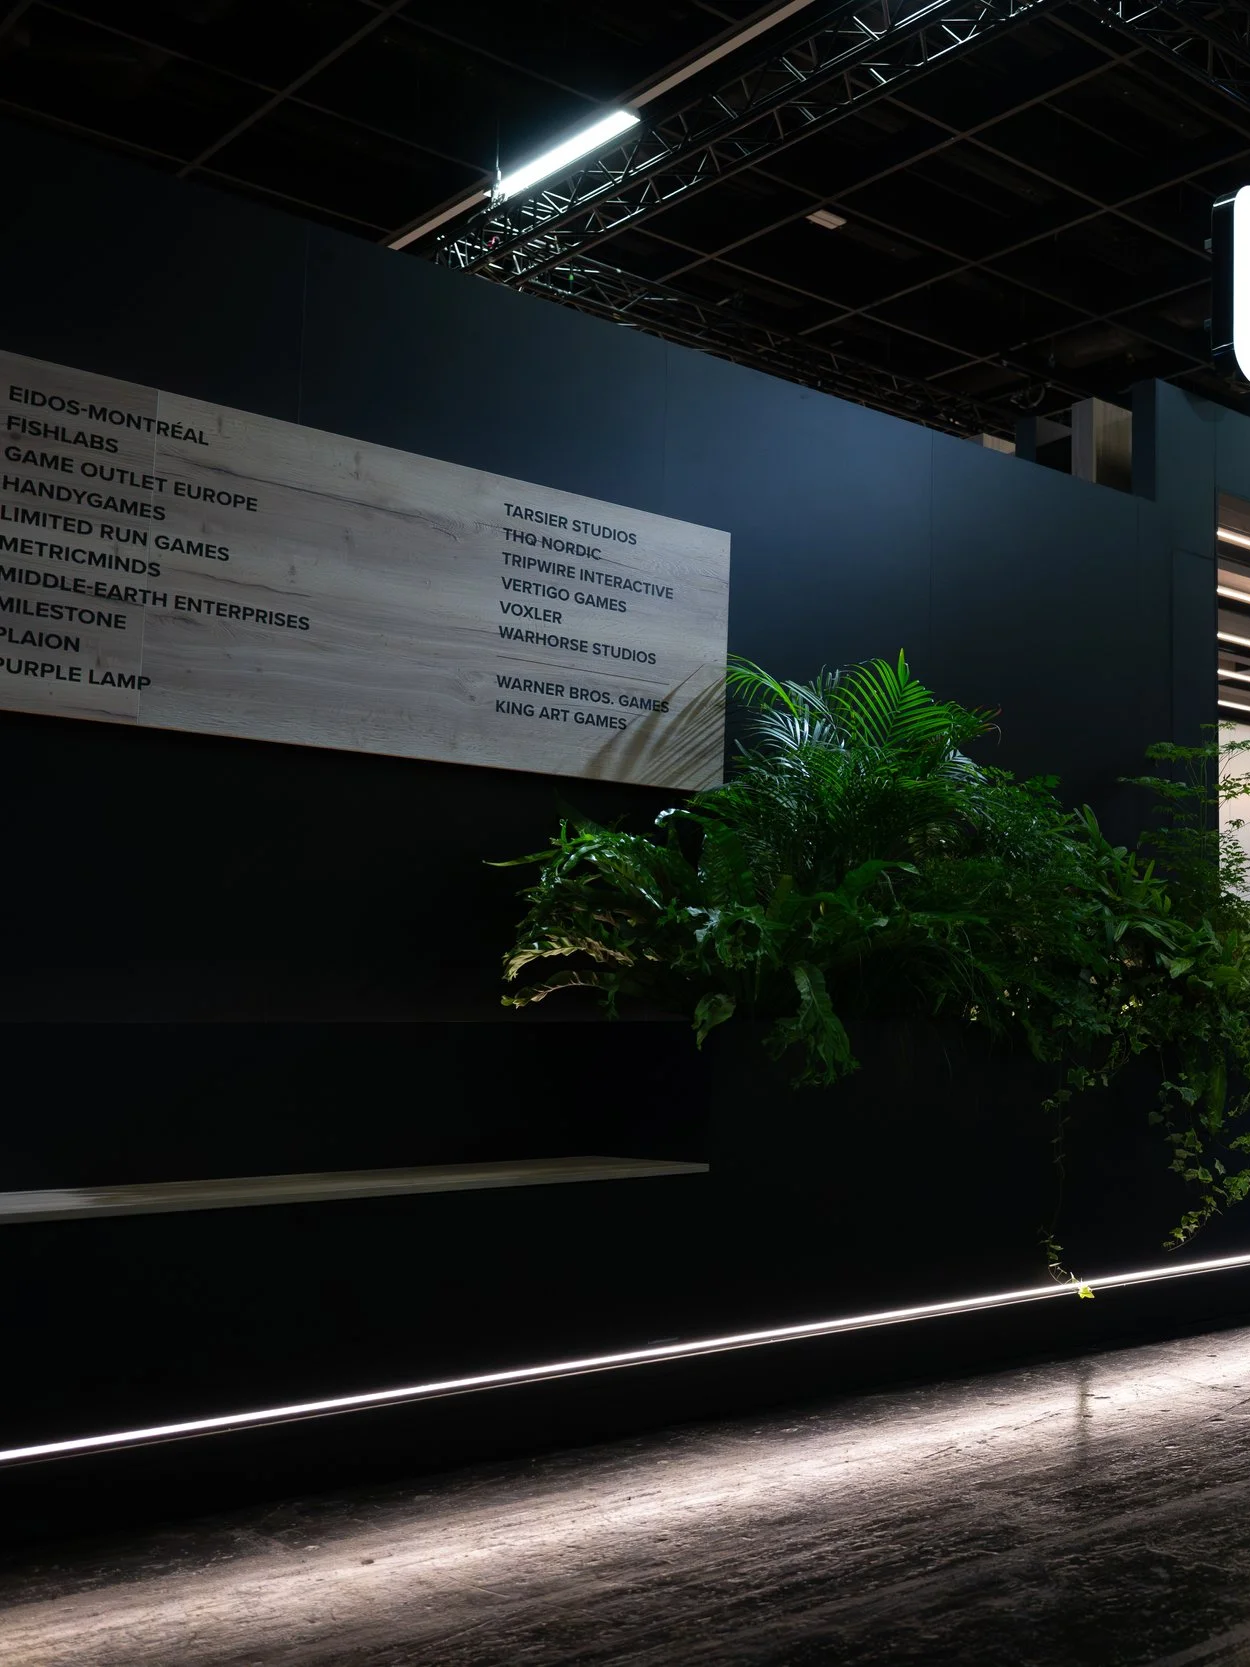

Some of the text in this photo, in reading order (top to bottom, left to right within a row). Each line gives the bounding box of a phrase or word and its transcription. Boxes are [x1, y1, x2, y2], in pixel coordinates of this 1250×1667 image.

[6, 415, 119, 454] FISHLABS
[8, 385, 209, 446] EIDOS-MONTRÉAL
[2, 475, 166, 521] HANDYGAMES
[5, 446, 259, 512] GAME OUTLET EUROPE
[0, 505, 230, 562] LIMITED RUN GAMES
[503, 527, 602, 561] THQ NORDIC
[504, 503, 637, 545] TARSIER STUDIOS
[0, 534, 161, 577] METRICMINDS
[501, 576, 627, 613] VERTIGO GAMES
[502, 552, 674, 600] TRIPWIRE INTERACTIVE
[0, 565, 310, 631] MIDDLE-EARTH ENTERPRISES
[0, 595, 127, 630] MILESTONE
[499, 600, 562, 624] VOXLER
[498, 625, 656, 665] WARHORSE STUDIOS
[0, 658, 151, 691] URPLE LAMP
[496, 674, 669, 713] WARNER BROS. GAMES
[495, 699, 627, 730] KING ART GAMES
